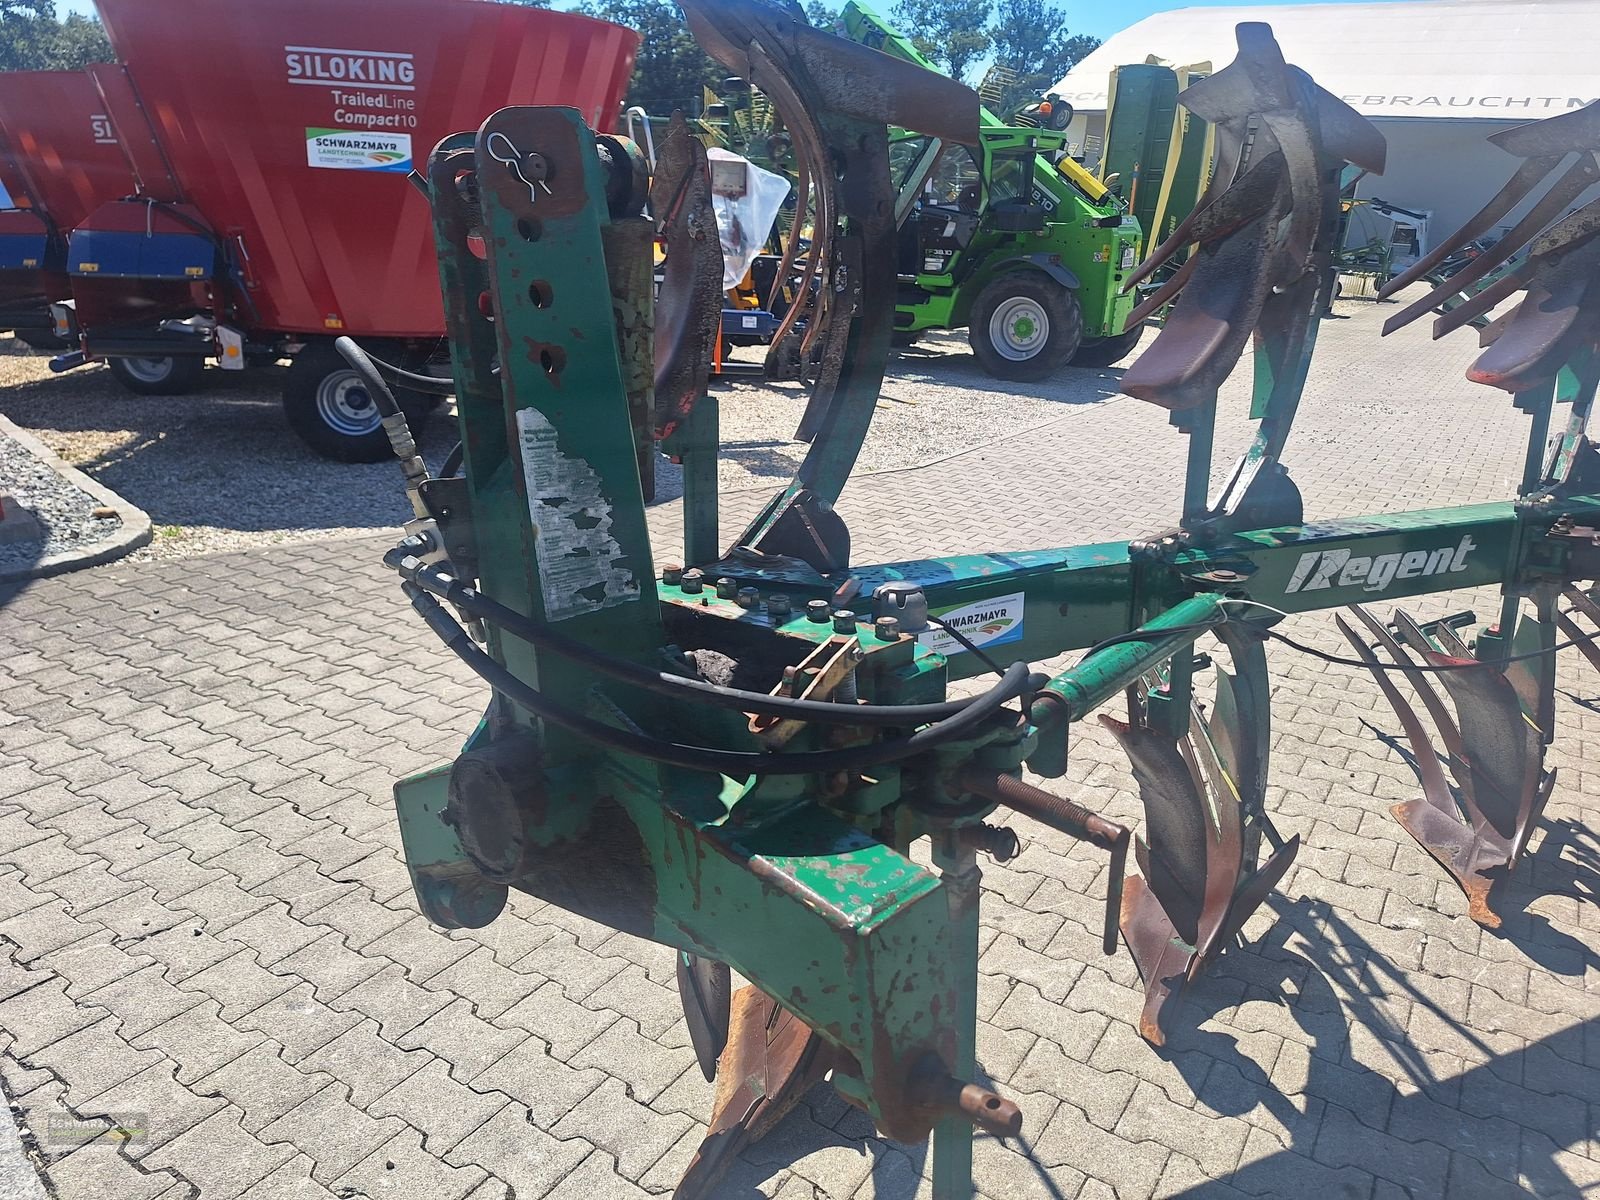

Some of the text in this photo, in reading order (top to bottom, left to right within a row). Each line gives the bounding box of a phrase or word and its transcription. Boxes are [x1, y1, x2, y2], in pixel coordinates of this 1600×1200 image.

[285, 54, 415, 83] SILOKING
[331, 90, 415, 110] TrailedLine
[1060, 91, 1599, 108] SCH EBRAUCHTM
[92, 120, 112, 138] SI
[316, 138, 397, 151] SCHWARZMAYR
[318, 148, 366, 157] LANDTECHNIK
[1031, 187, 1054, 211] 8.10
[1168, 215, 1177, 235] ONE
[1284, 534, 1478, 594] Regent
[945, 608, 1007, 628] HWARZMAYR
